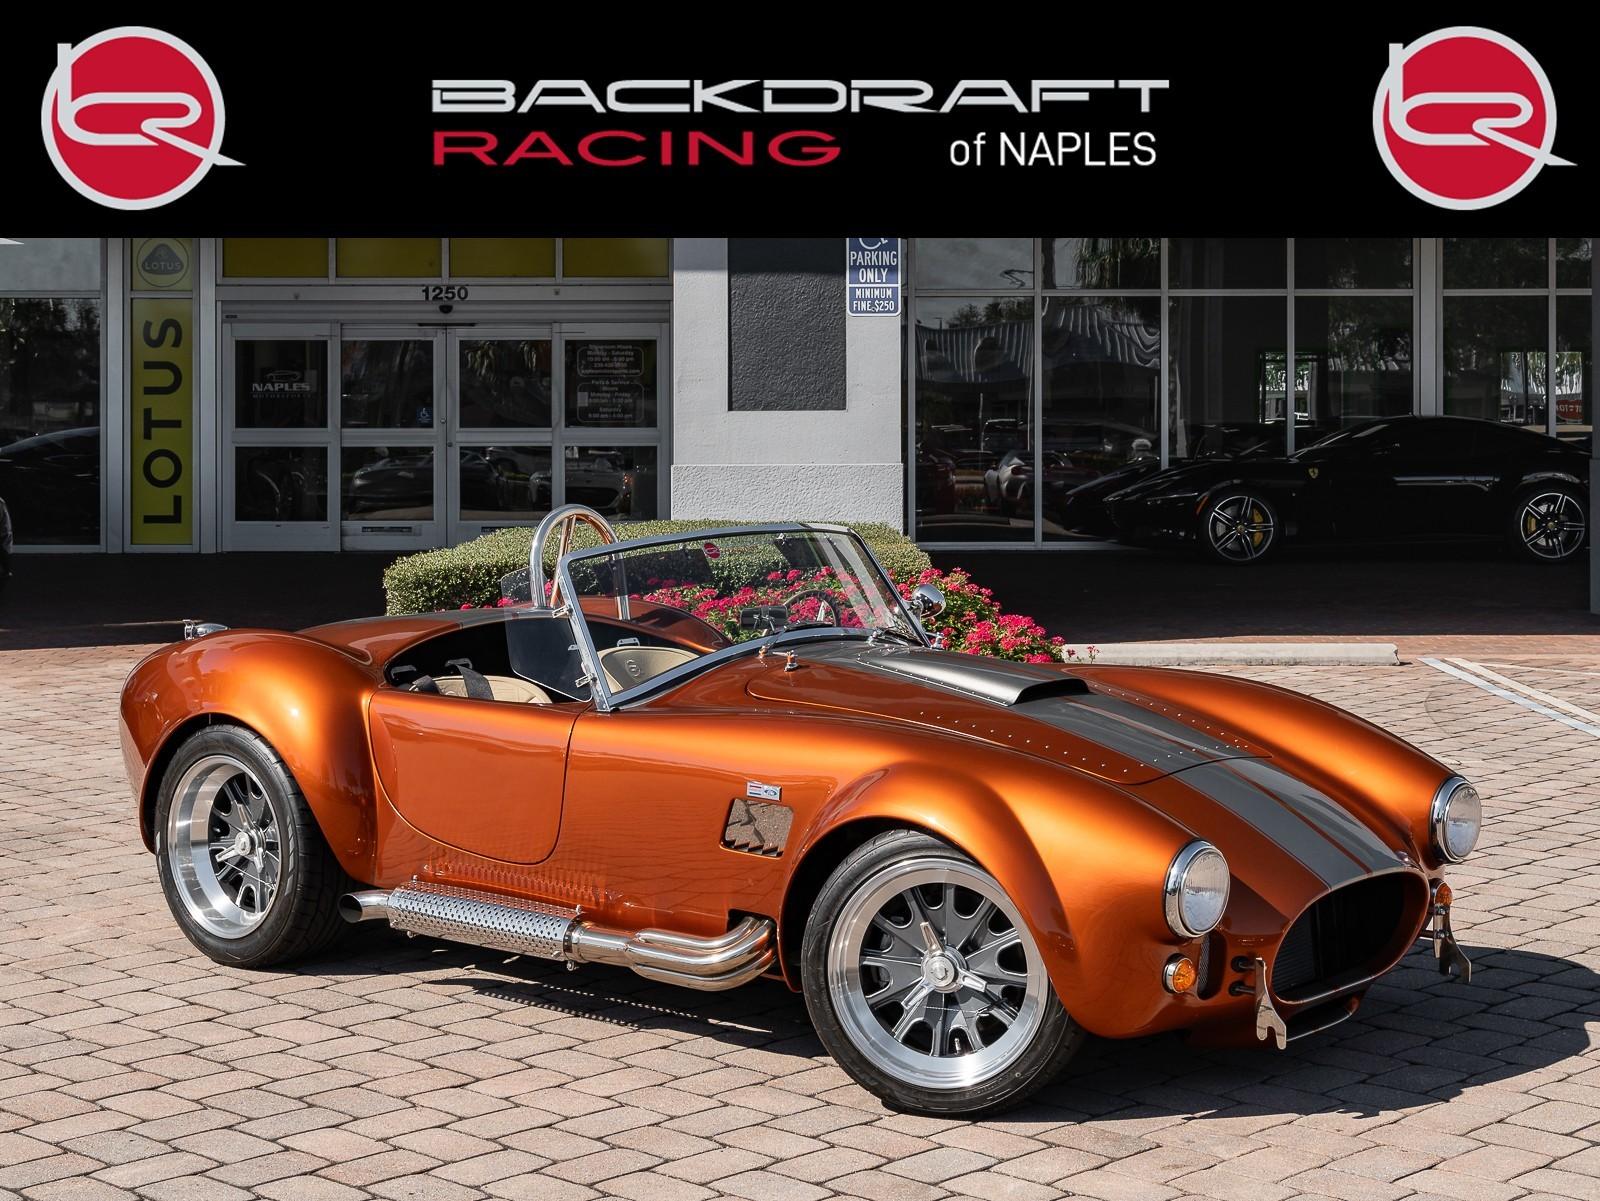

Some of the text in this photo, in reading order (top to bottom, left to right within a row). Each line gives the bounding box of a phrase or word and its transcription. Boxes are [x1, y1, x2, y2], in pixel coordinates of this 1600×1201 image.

[850, 251, 897, 266] PARKING
[145, 262, 181, 271] LOTUS
[859, 268, 888, 283] ONLY
[421, 285, 469, 301] 1250
[855, 287, 892, 299] MINIMUM
[853, 299, 895, 312] FINE $250
[252, 382, 311, 392] NAPLES
[142, 318, 183, 524] LOTUS
